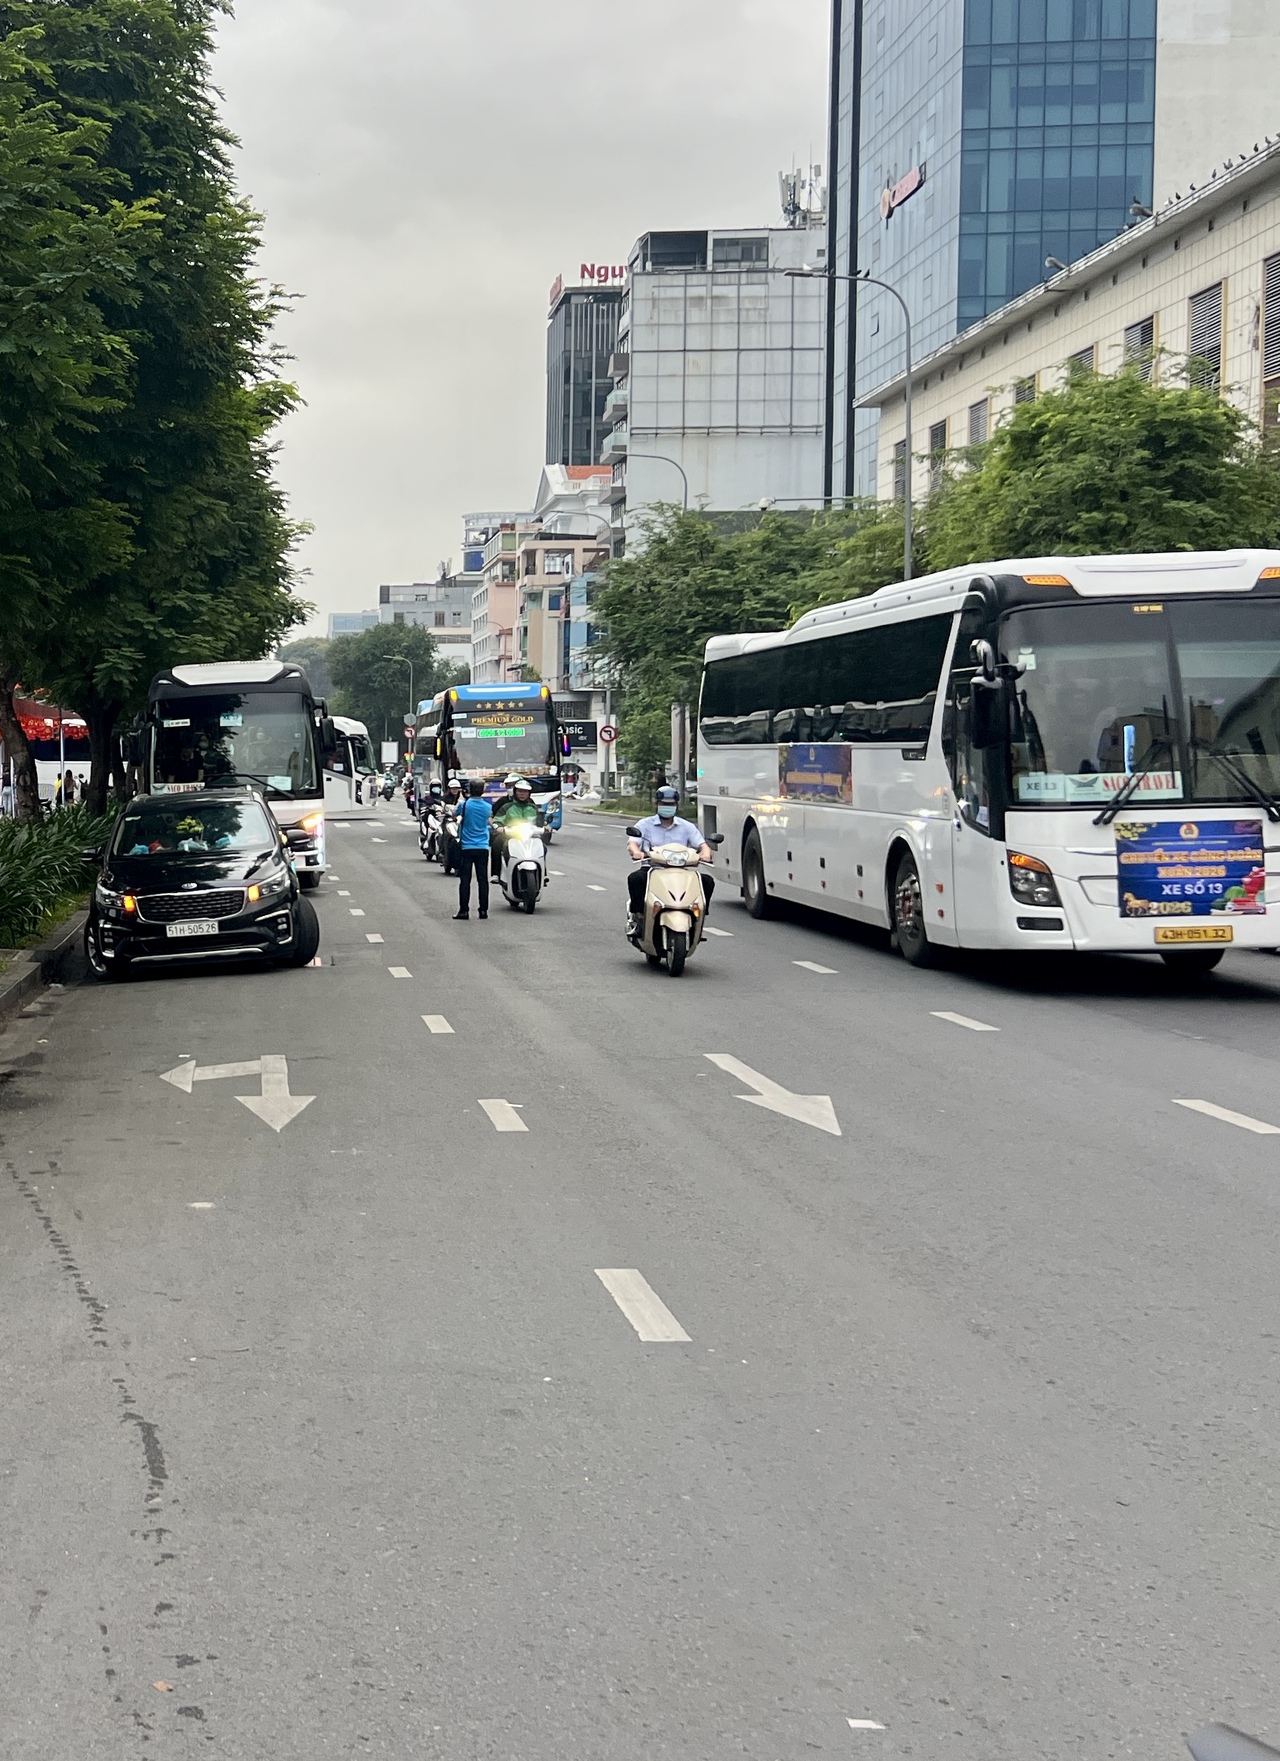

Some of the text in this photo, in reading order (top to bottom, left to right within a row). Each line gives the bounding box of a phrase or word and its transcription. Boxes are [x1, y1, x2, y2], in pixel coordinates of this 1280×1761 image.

[1026, 783, 1057, 791] XE 13
[1193, 865, 1227, 878] 2026
[1162, 880, 1223, 895] XE SỐ 13
[1149, 902, 1193, 914] 2026
